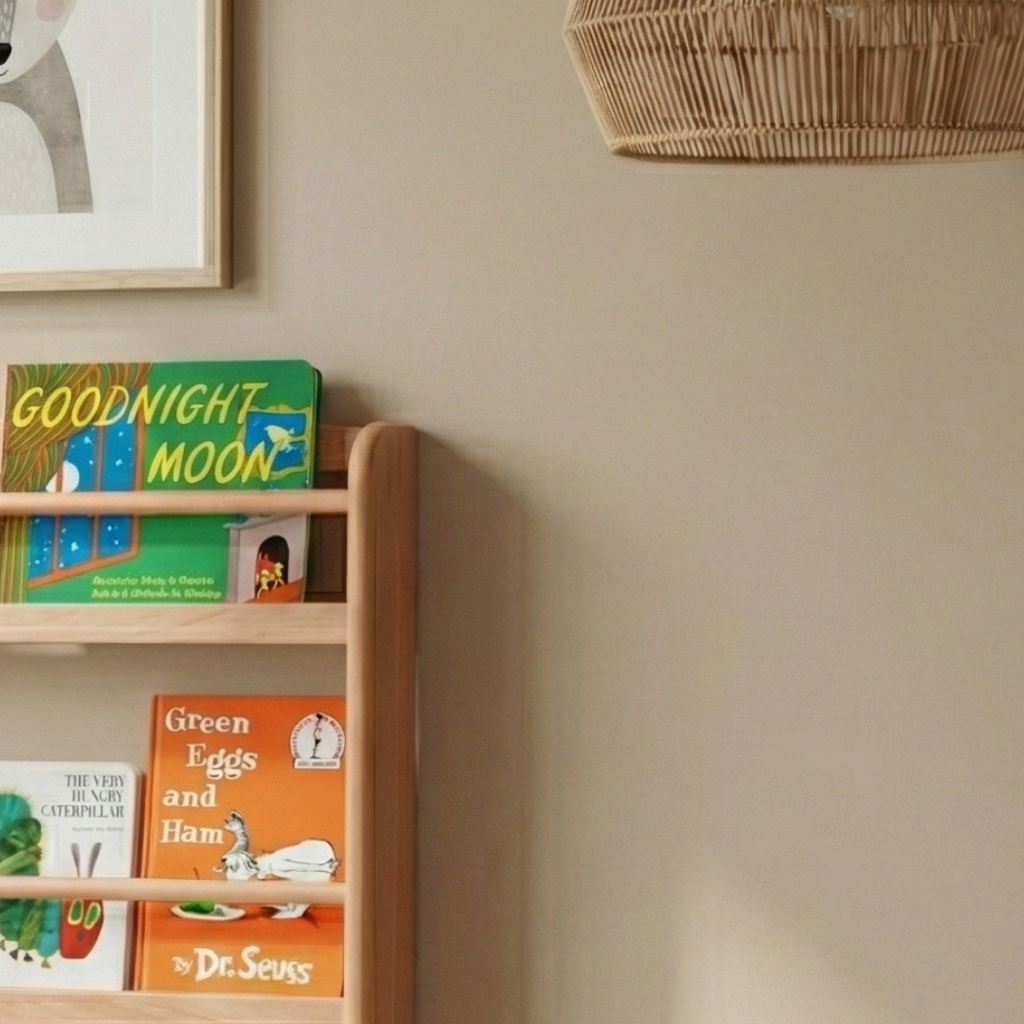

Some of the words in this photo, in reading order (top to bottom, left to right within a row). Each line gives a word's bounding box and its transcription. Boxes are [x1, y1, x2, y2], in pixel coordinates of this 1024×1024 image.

[12, 383, 268, 428] GOODNIGHT
[147, 441, 284, 484] MOON
[165, 706, 250, 734] Green
[186, 743, 258, 780] Eggs
[65, 774, 90, 787] THE
[93, 774, 125, 788] VERY
[162, 784, 217, 808] and
[41, 805, 124, 818] CATERPILLAR
[160, 819, 224, 845] Ham
[193, 947, 236, 982] Dr.
[238, 946, 312, 985] Seuss
